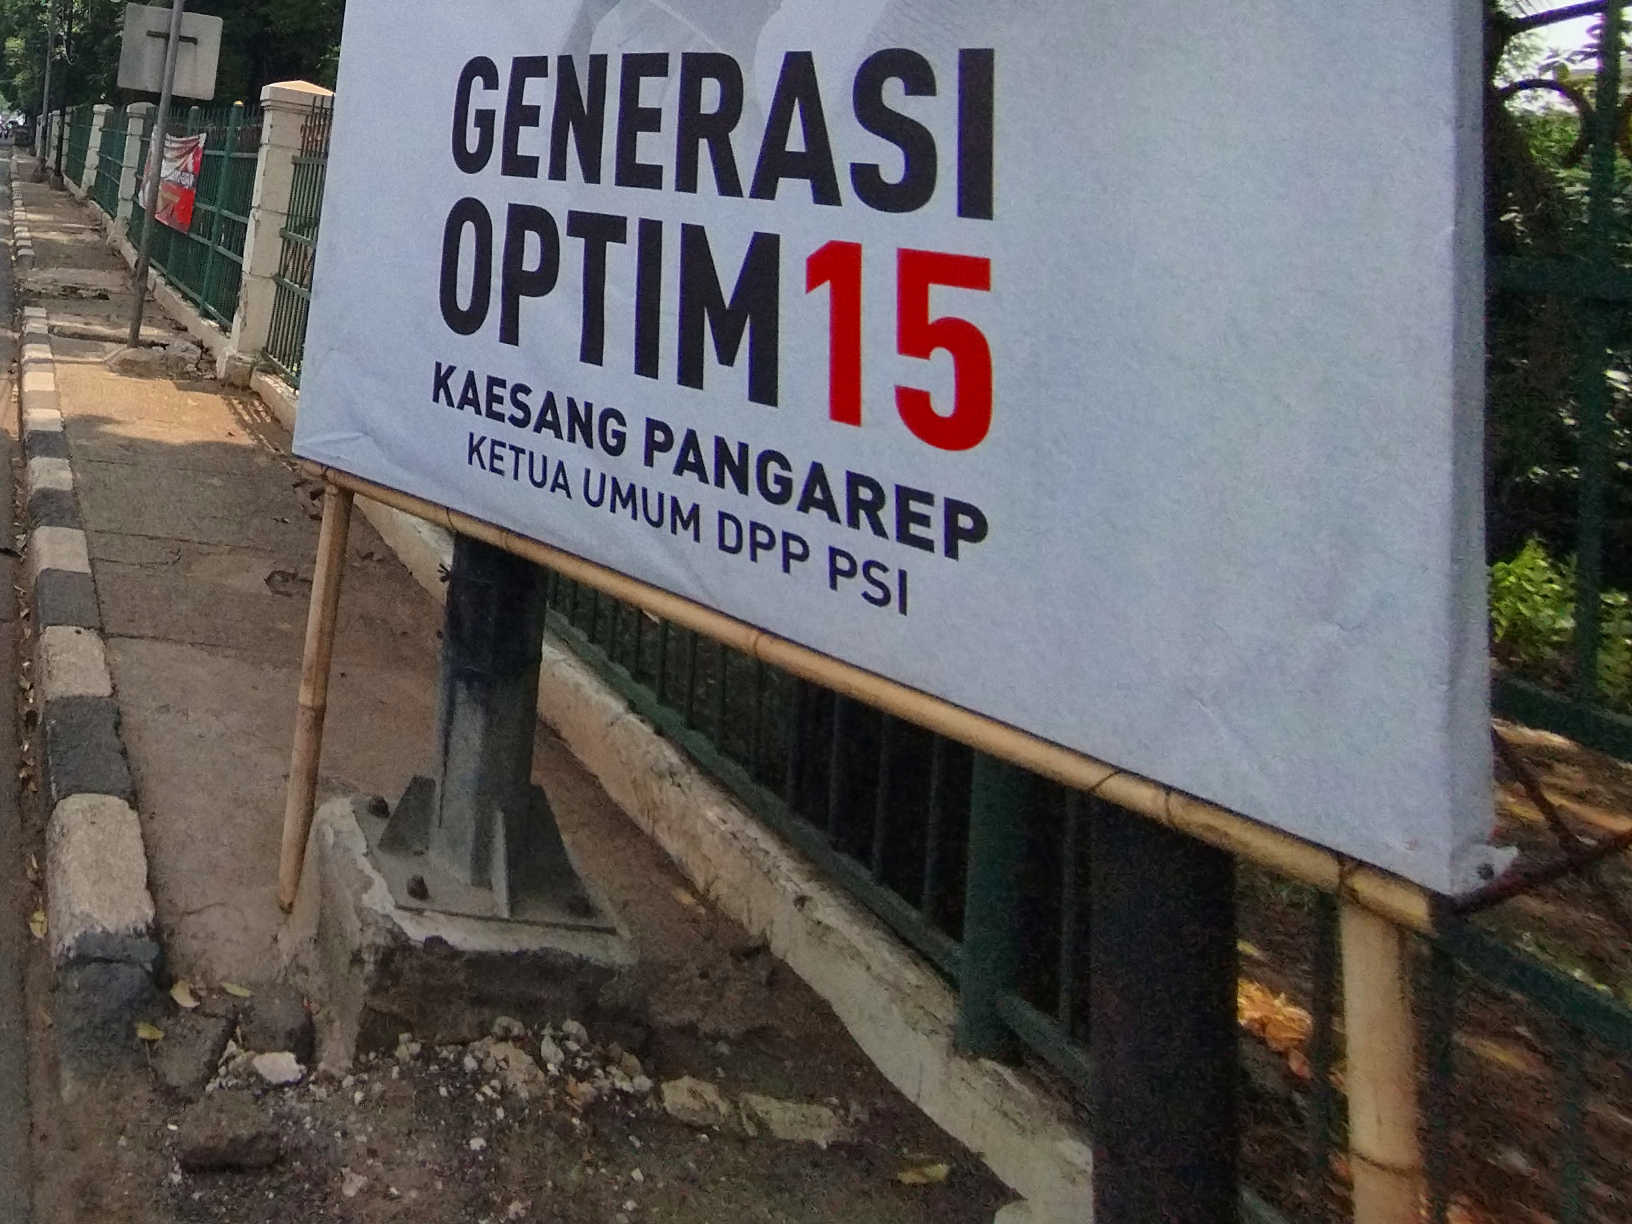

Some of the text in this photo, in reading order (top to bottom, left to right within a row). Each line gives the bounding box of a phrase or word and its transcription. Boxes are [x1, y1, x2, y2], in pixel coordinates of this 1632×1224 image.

[451, 47, 995, 221] GENERASI
[439, 196, 994, 452] OPTIM15
[432, 360, 989, 561] KAESANG PANGAREP
[467, 431, 908, 617] KETUA UMUM DPP PSI
